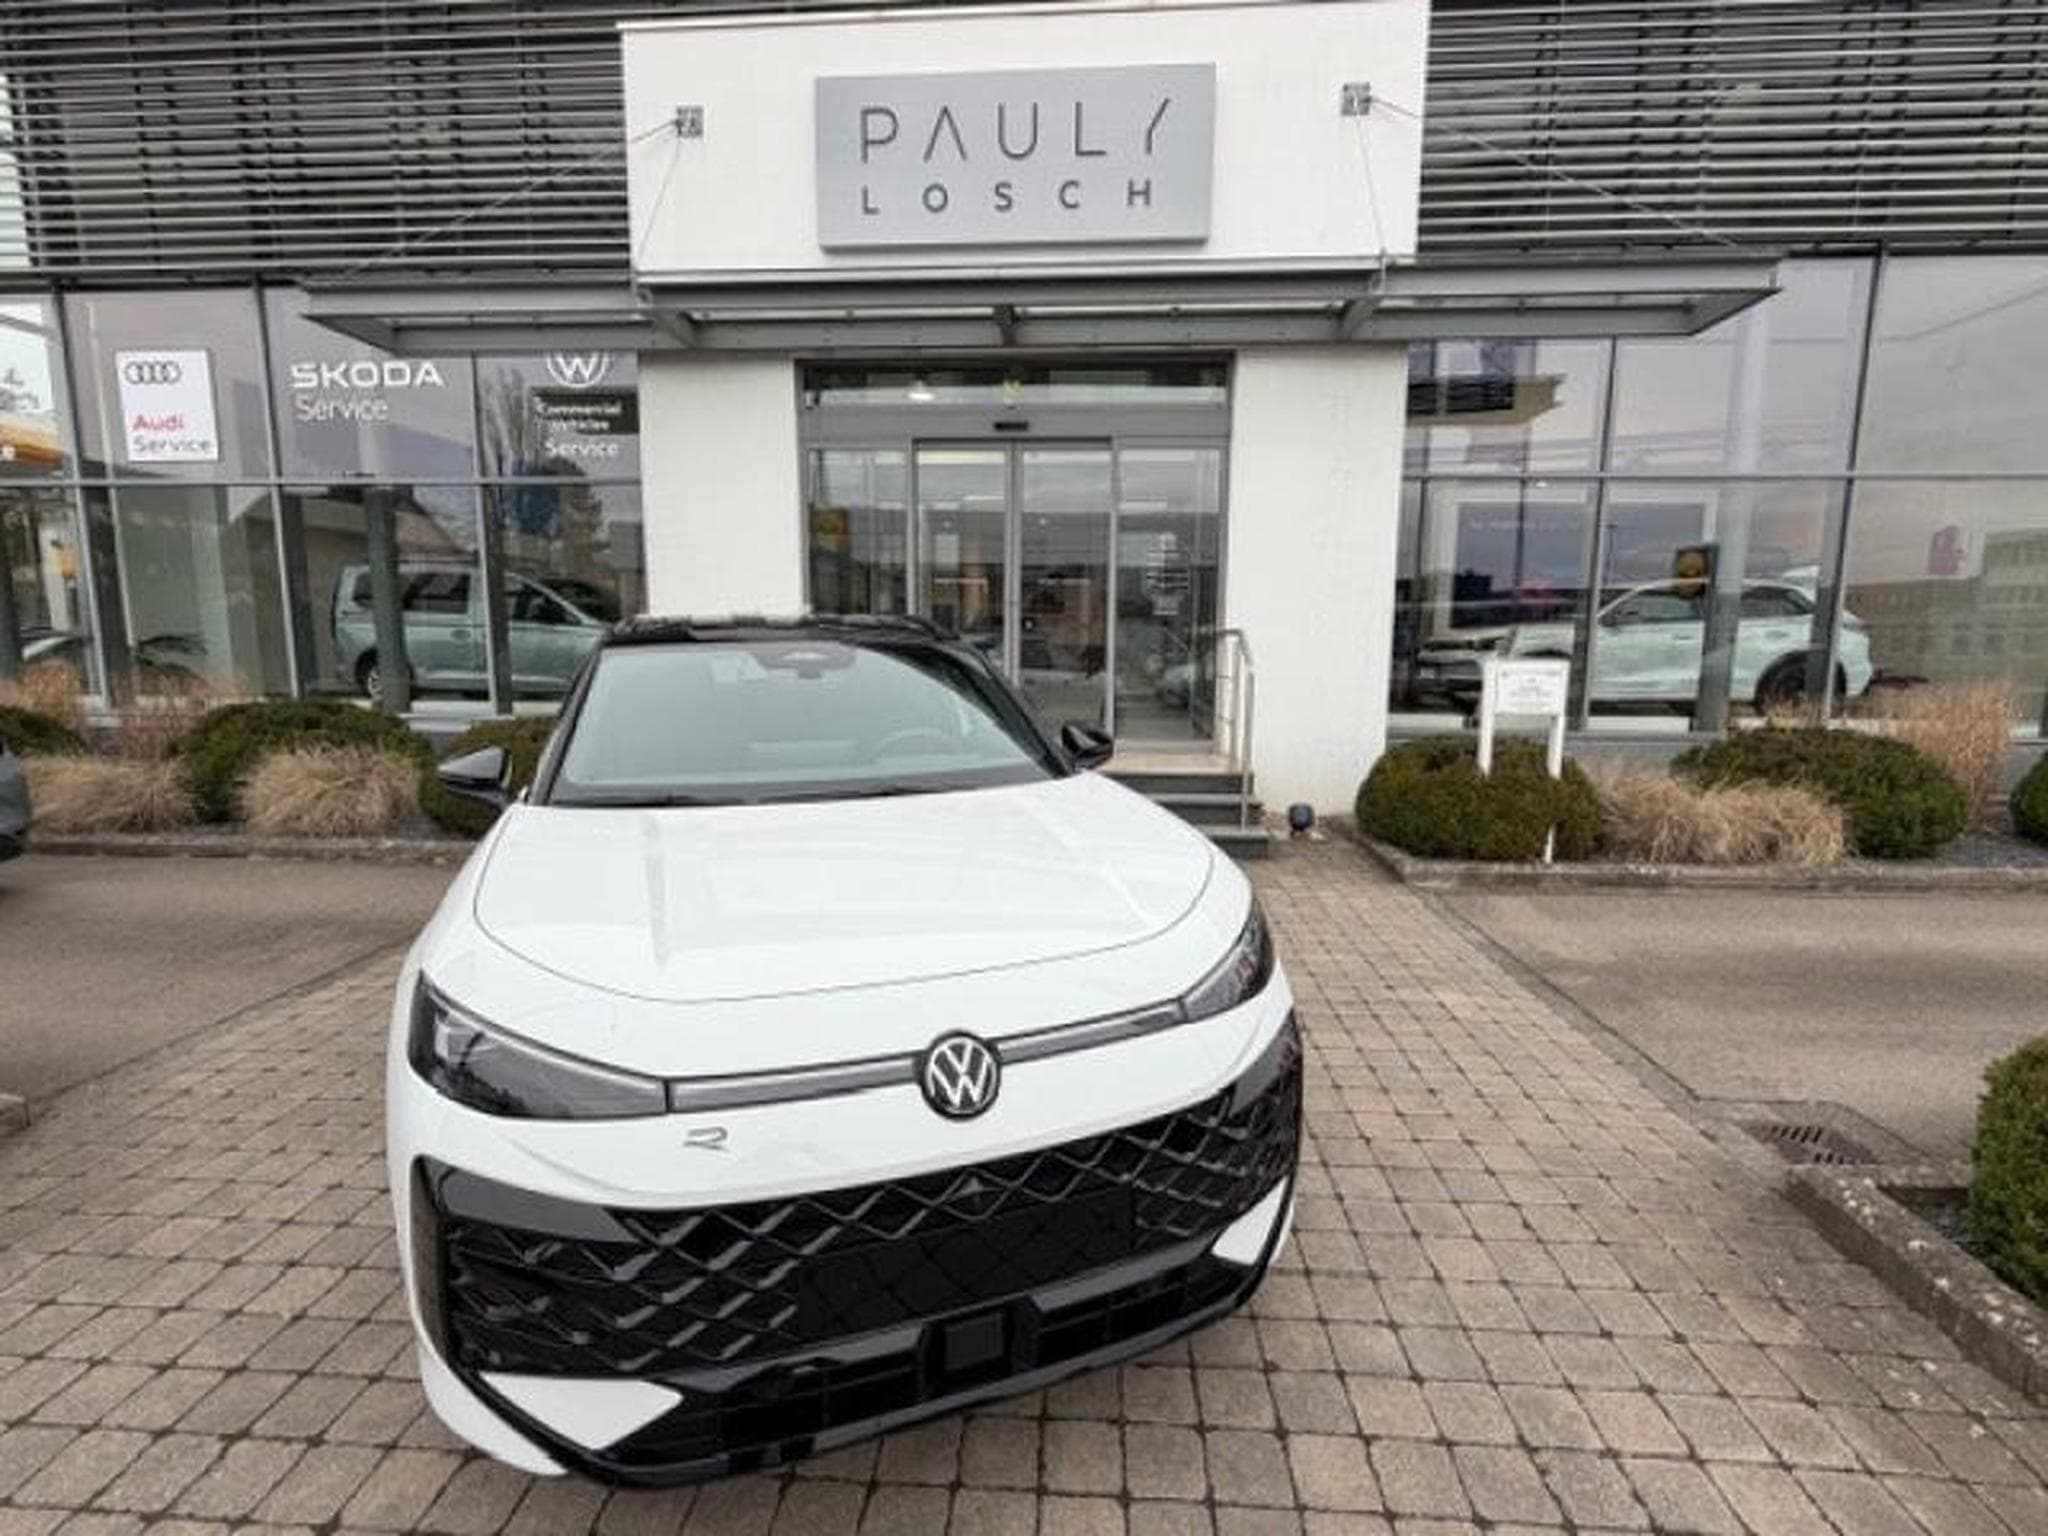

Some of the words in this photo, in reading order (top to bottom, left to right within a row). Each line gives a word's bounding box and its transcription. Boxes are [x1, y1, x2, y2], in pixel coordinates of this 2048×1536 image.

[860, 97, 1171, 164] PAULY
[861, 178, 1153, 216] LOSCH
[295, 392, 389, 421] Service
[132, 414, 184, 431] Audi
[133, 434, 211, 453] Service
[544, 438, 620, 457] Service
